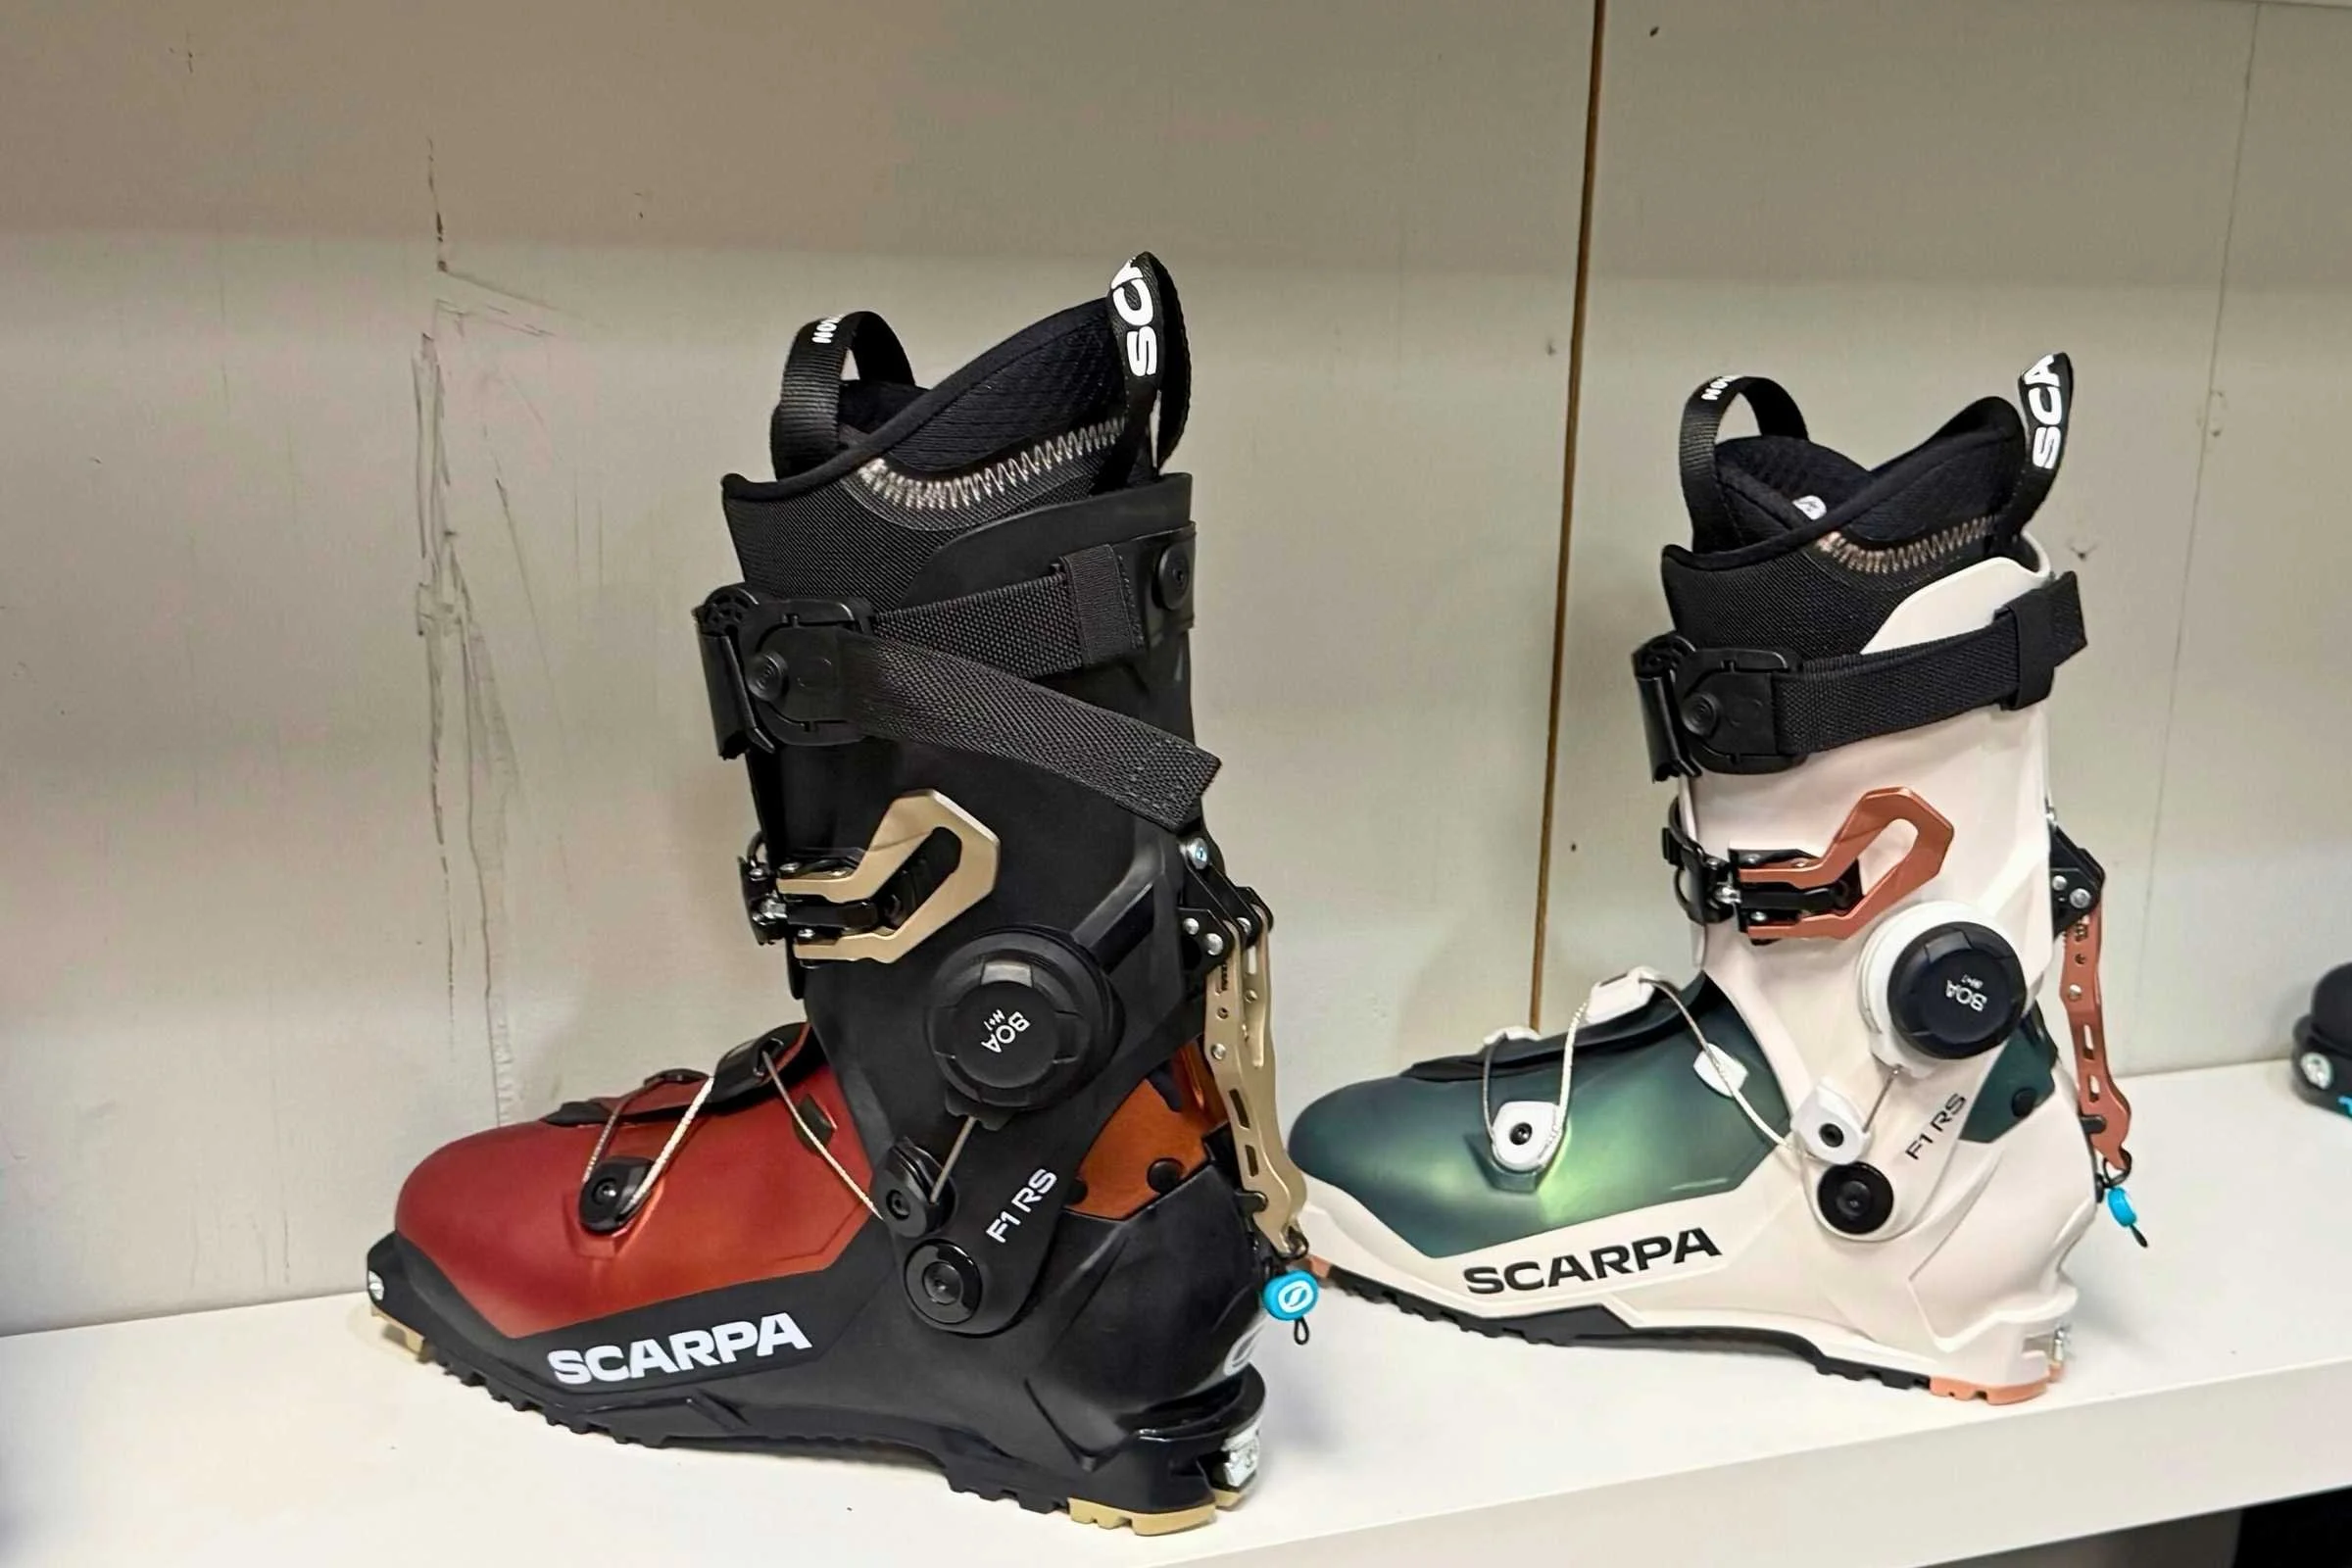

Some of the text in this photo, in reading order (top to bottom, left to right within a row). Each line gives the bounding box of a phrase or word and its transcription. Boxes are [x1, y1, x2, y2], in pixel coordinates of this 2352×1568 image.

[1945, 979, 1988, 1011] BOA
[980, 1010, 1031, 1054] BOA
[1905, 1093, 1967, 1160] F1 RS
[986, 1168, 1057, 1244] F1 RS
[1463, 1227, 1723, 1295] SCARPA
[547, 1312, 813, 1385] SCARPA
